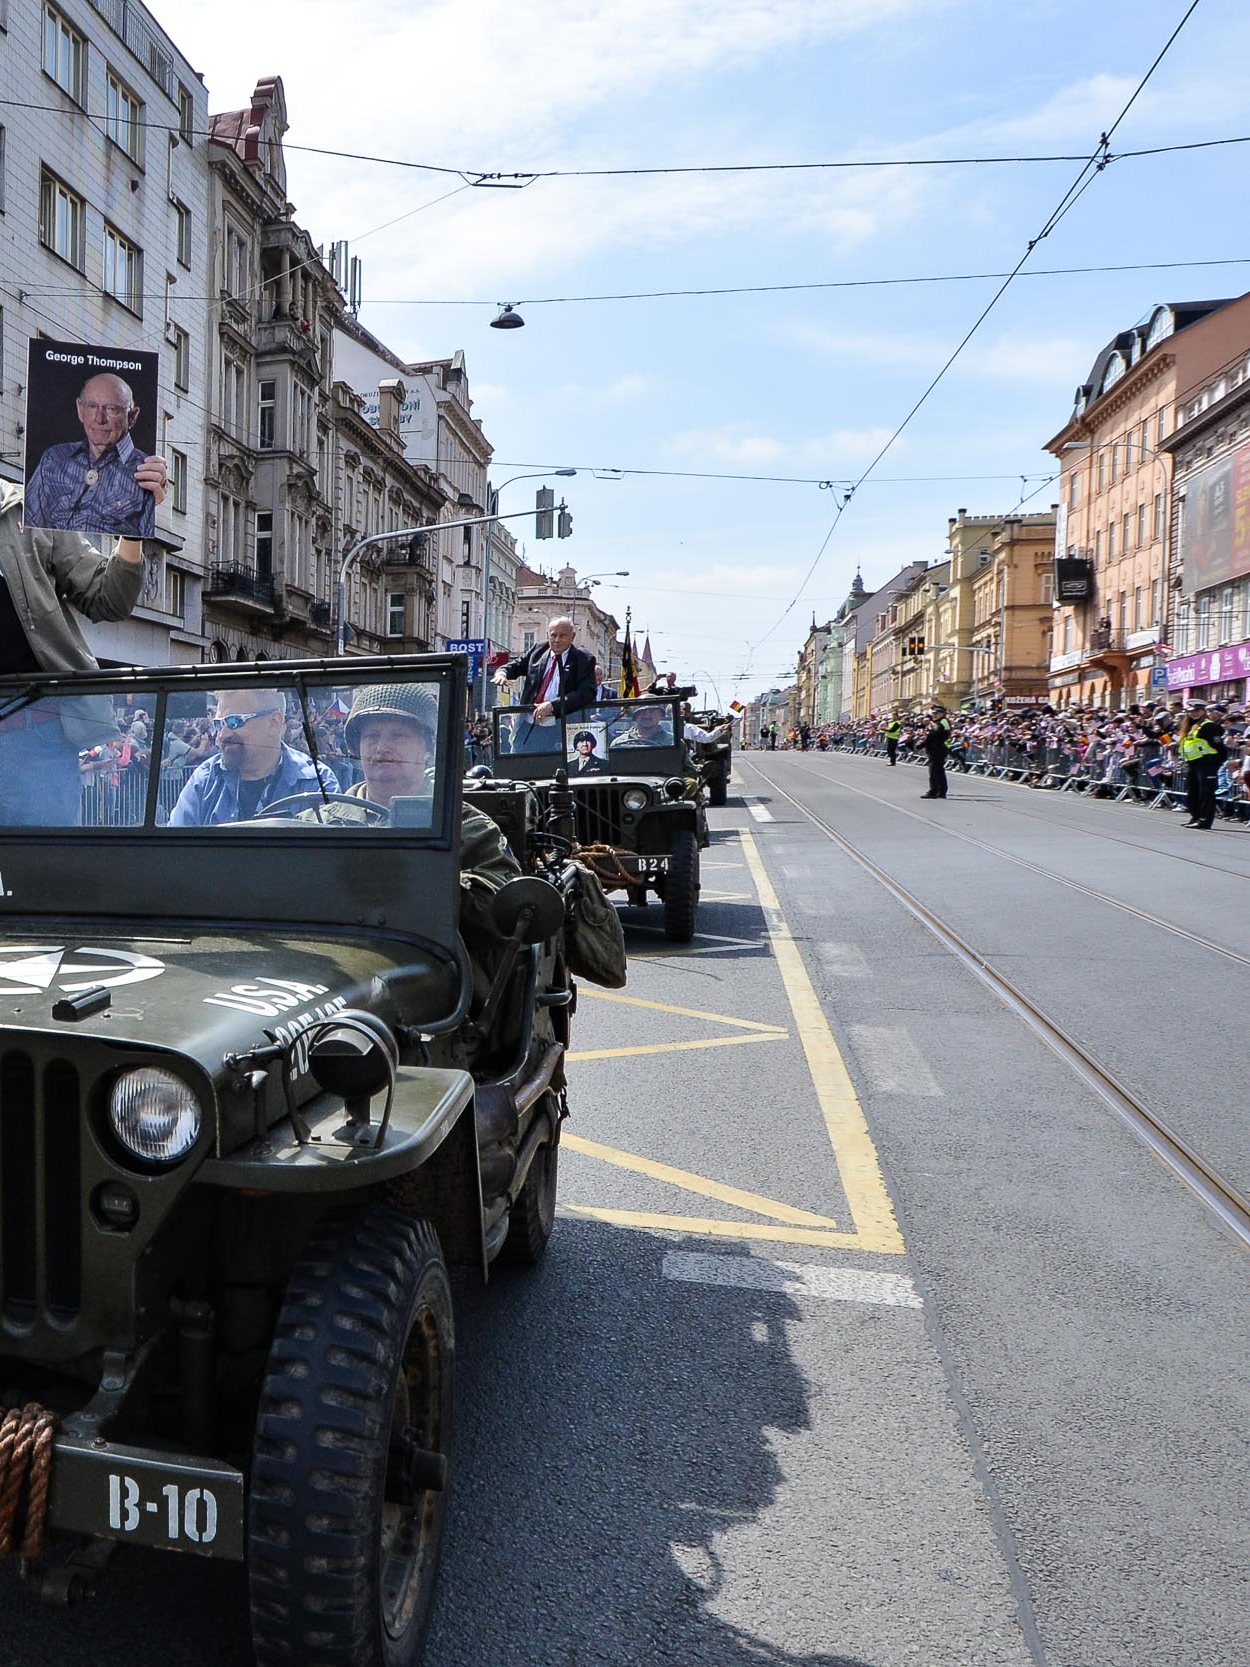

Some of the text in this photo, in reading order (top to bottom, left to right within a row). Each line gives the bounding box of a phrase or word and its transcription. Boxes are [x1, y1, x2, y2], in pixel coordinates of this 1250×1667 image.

[45, 350, 142, 371] George Thompson
[1154, 669, 1165, 681] P
[108, 1474, 218, 1543] B-10
